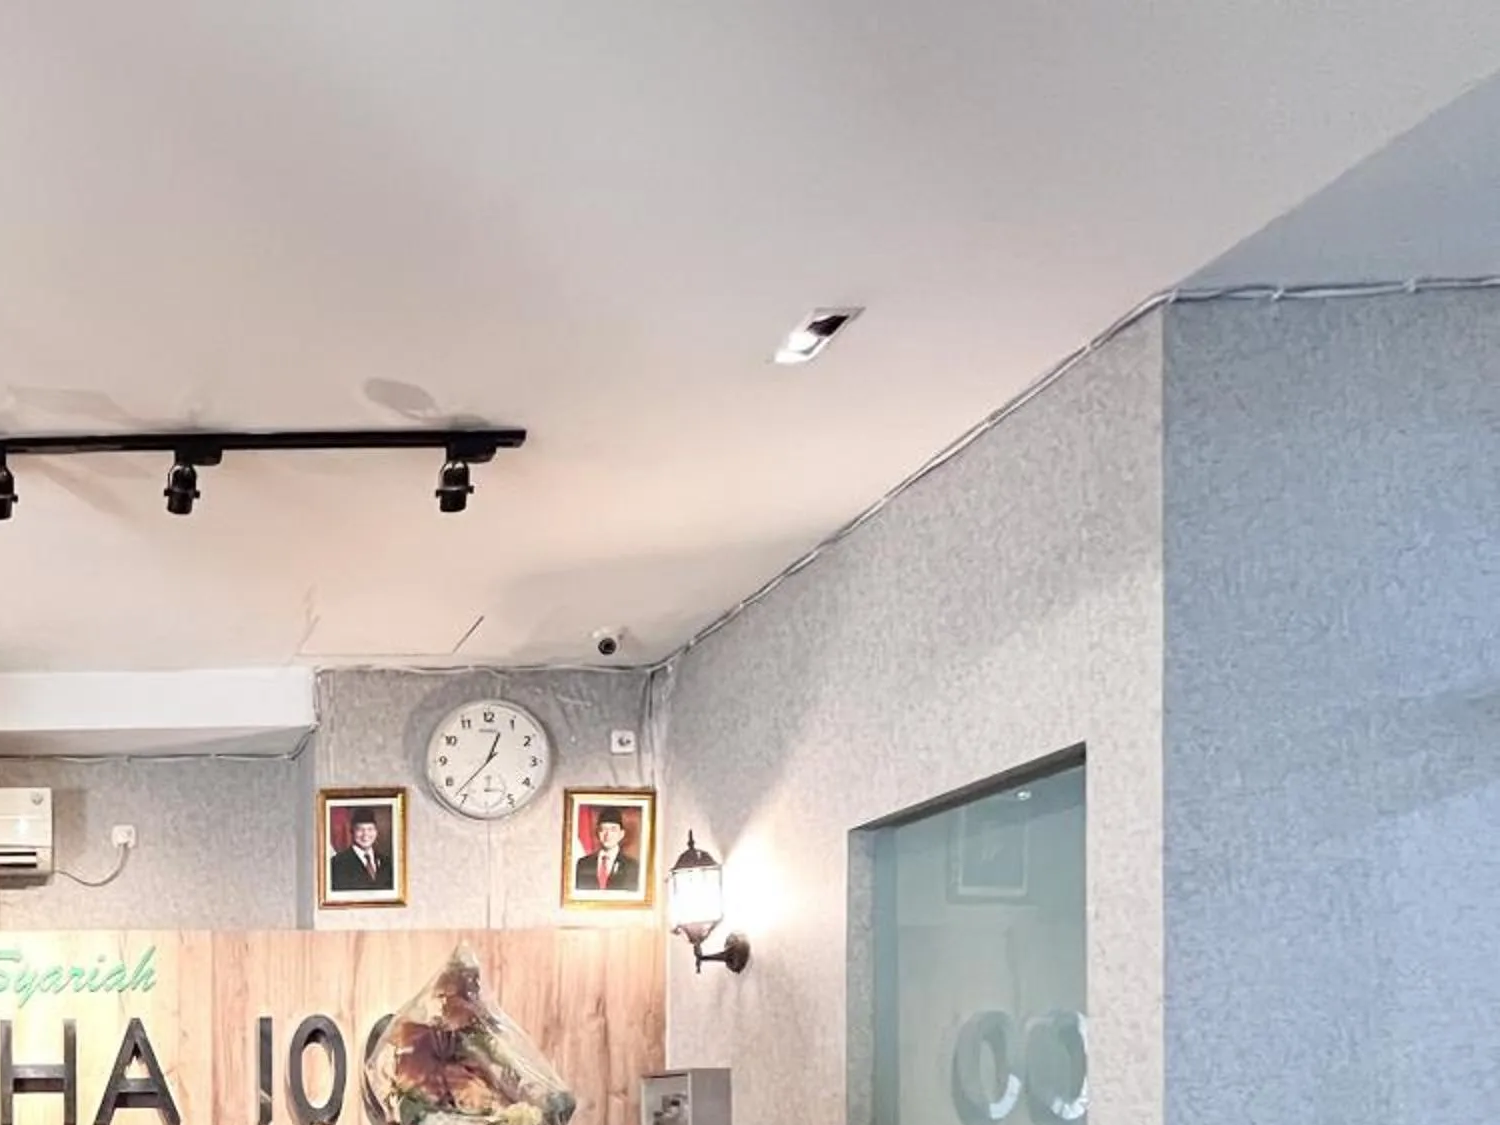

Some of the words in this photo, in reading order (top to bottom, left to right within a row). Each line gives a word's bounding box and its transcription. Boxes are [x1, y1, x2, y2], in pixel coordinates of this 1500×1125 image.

[483, 711, 495, 723] 12
[461, 719, 471, 729] 11
[445, 735, 457, 746] 10
[523, 735, 531, 747] 2
[439, 755, 448, 766] 9
[530, 756, 538, 767] 3
[460, 793, 468, 804] 7
